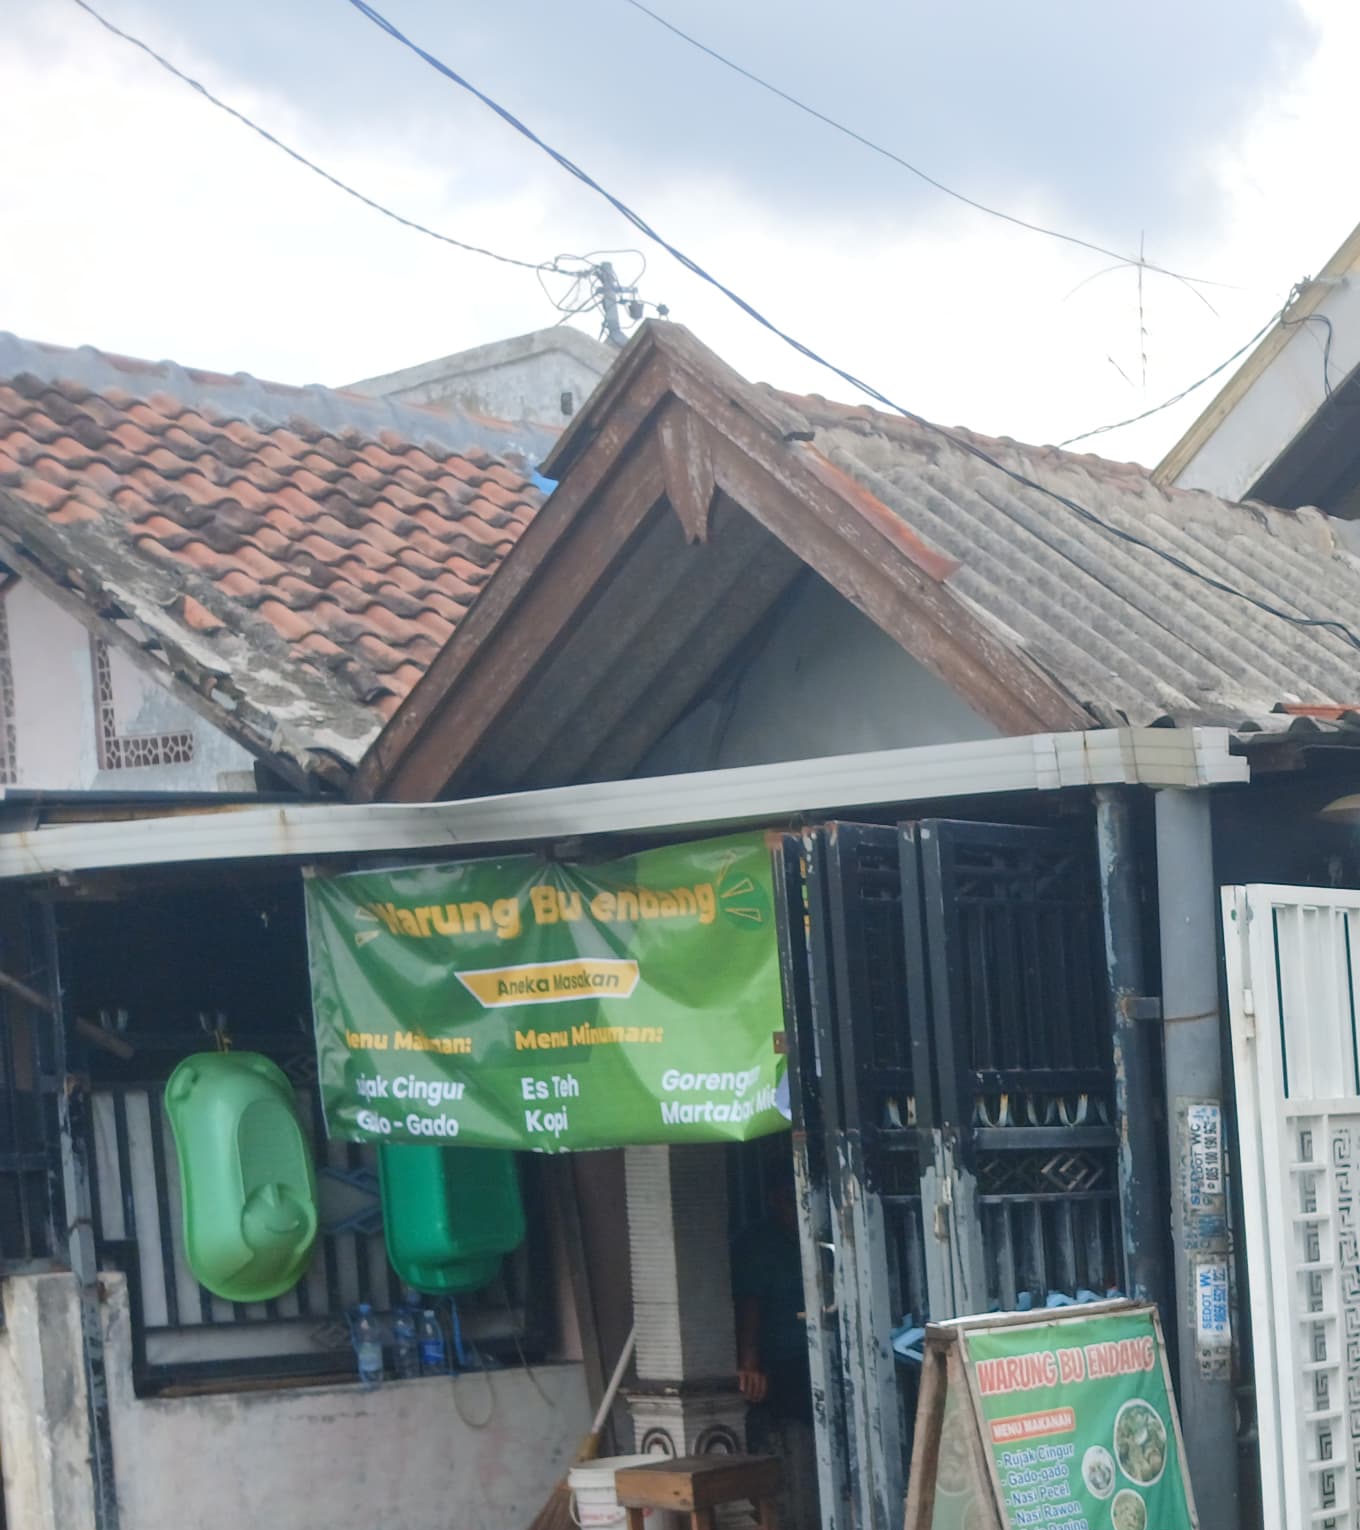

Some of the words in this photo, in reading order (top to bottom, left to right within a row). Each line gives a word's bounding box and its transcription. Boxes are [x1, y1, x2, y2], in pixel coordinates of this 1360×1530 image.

[530, 885, 582, 924] Bu
[497, 977, 550, 996] Aneka
[553, 969, 619, 992] Masakan
[515, 1029, 568, 1050] Menu
[392, 1074, 465, 1107] Cingur
[521, 1077, 549, 1101] Es
[552, 1073, 579, 1098] Teh
[406, 1113, 460, 1136] Gado
[525, 1106, 568, 1138] Kopi
[1202, 1294, 1212, 1329] SEDOT
[976, 1352, 1057, 1395] WARUNG
[1056, 1347, 1085, 1383] BU
[1085, 1336, 1156, 1378] ENDANG
[992, 1422, 1022, 1439] MENU
[1003, 1449, 1036, 1467] Rujak
[1037, 1443, 1074, 1460] Cingur
[1013, 1490, 1037, 1504] Nasi
[1040, 1481, 1071, 1498] Pecel
[1043, 1501, 1081, 1517] Rawon
